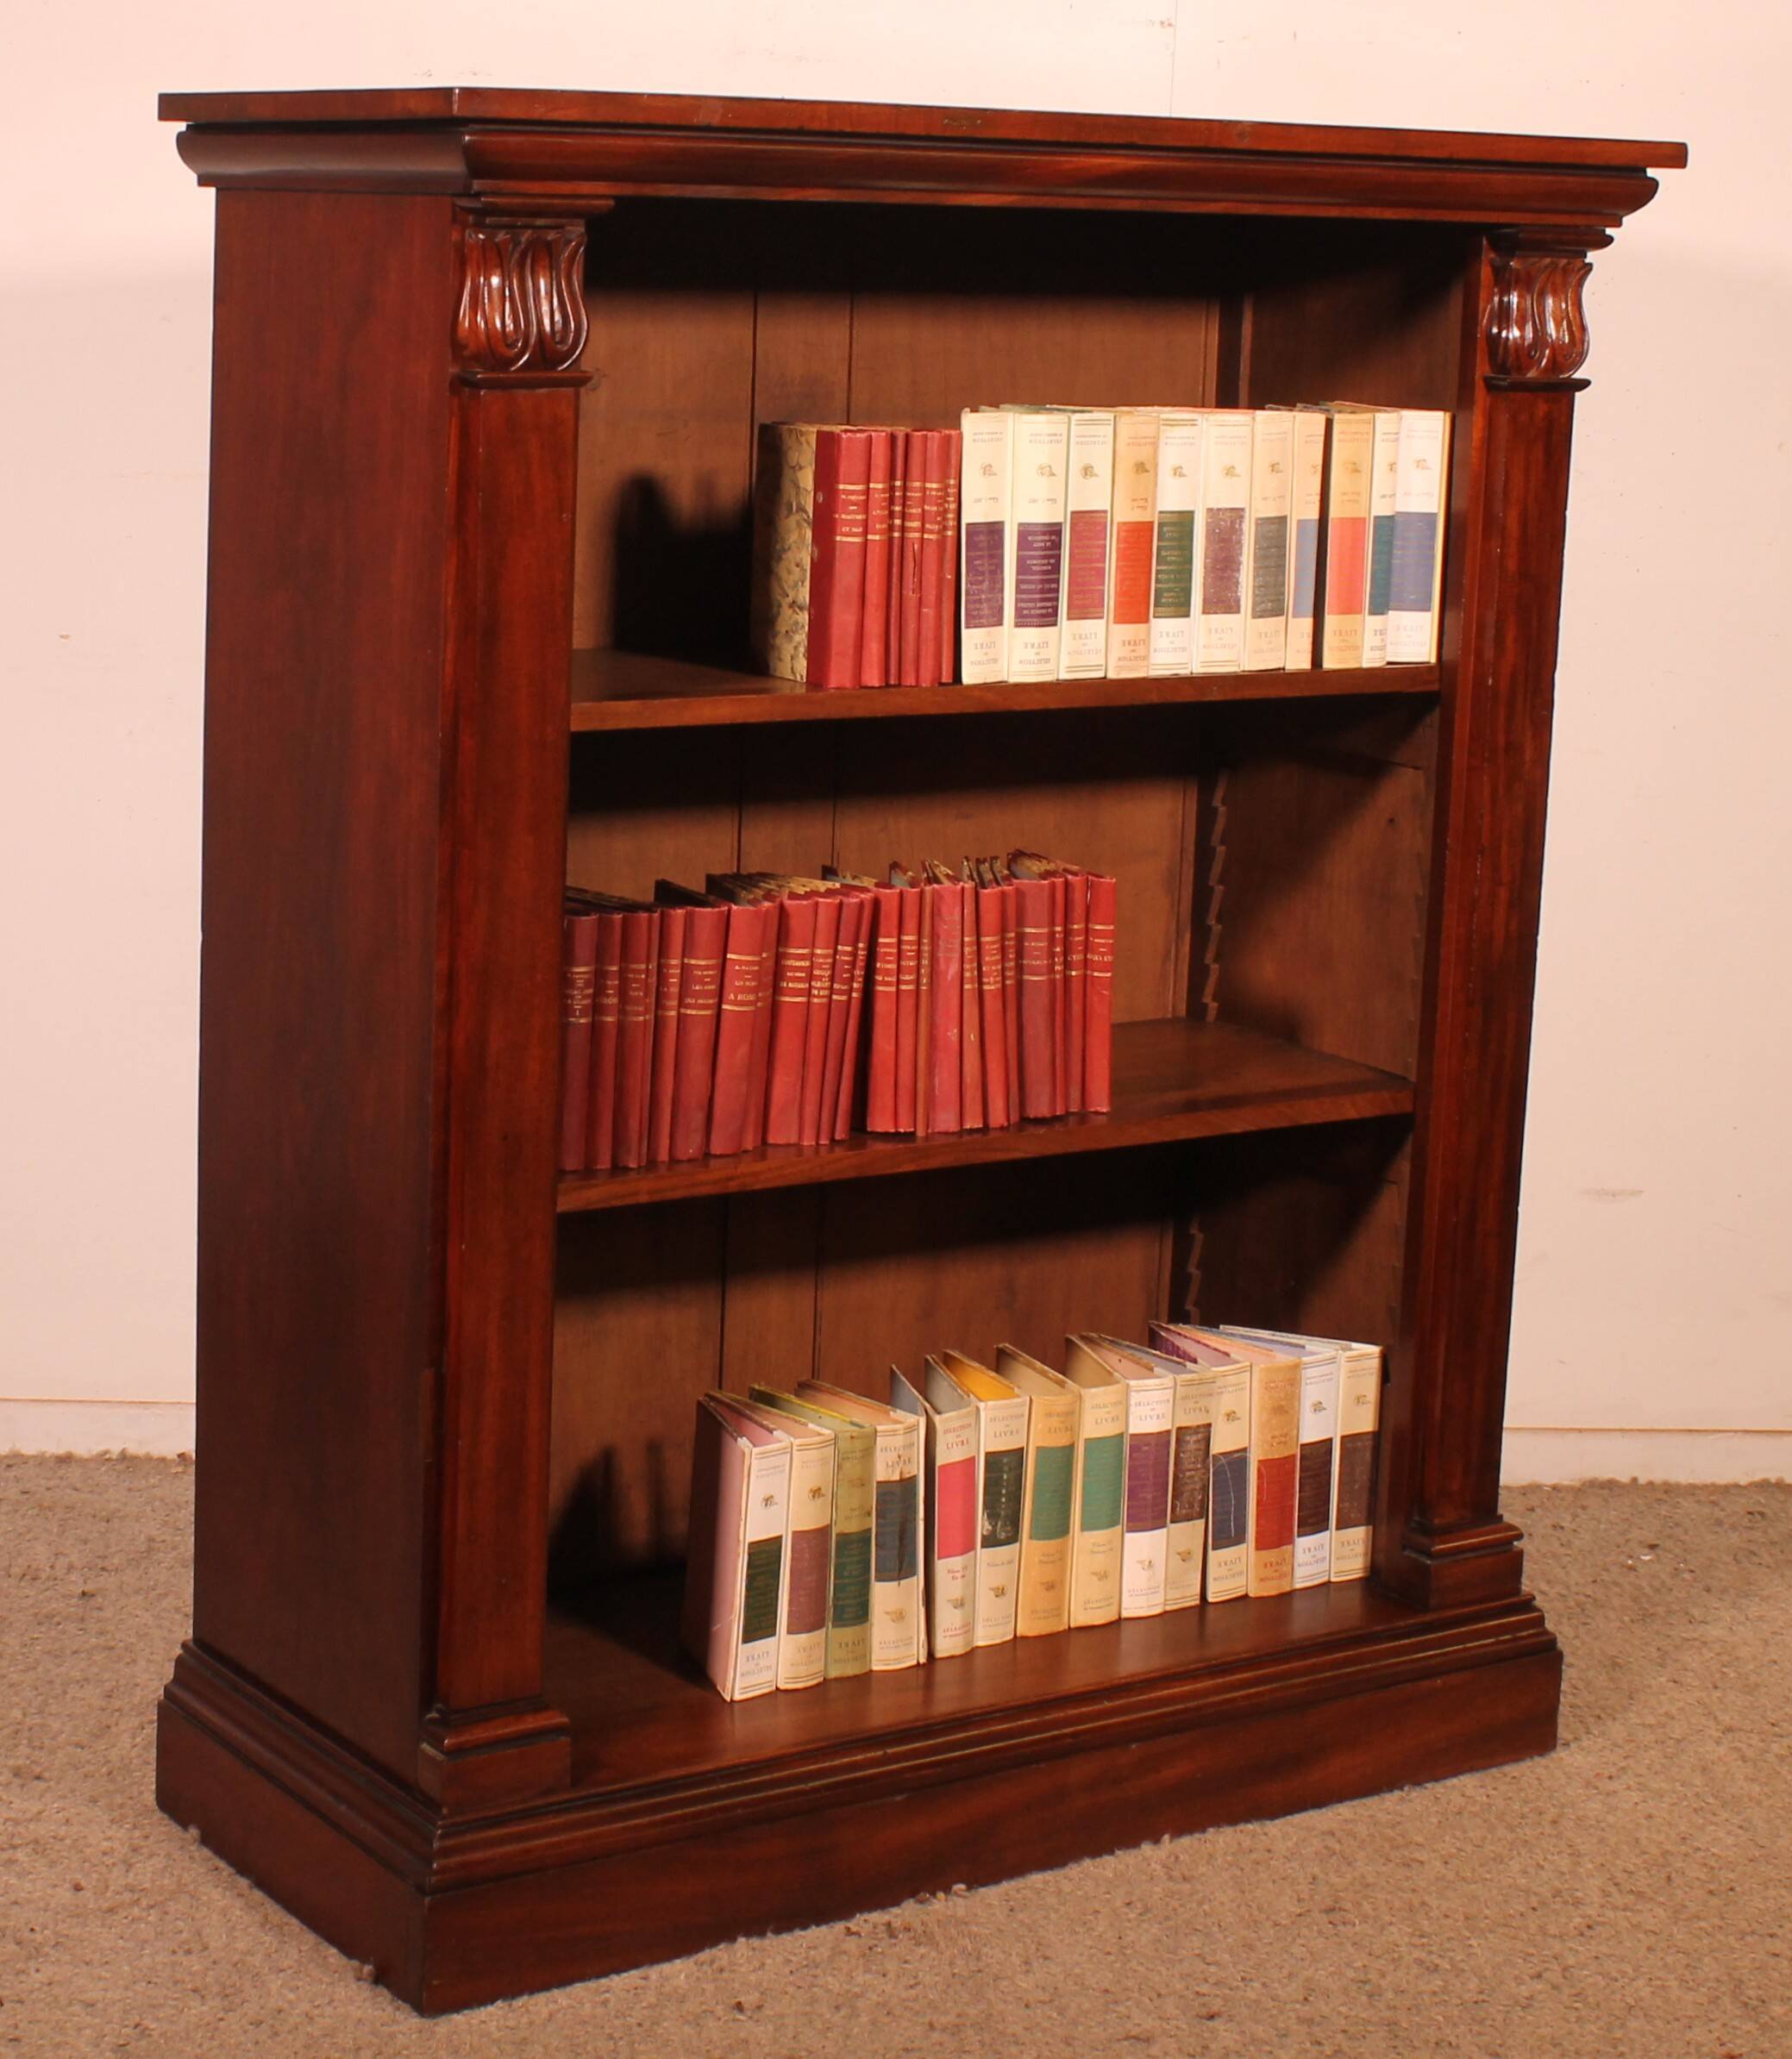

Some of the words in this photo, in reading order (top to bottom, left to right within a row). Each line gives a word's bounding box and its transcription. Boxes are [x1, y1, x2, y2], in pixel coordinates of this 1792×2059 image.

[1095, 1414, 1120, 1425] LIVRE
[1138, 1412, 1166, 1422] LIVRE
[993, 1428, 1019, 1438] LIVRE
[946, 1438, 970, 1450] LIVRE
